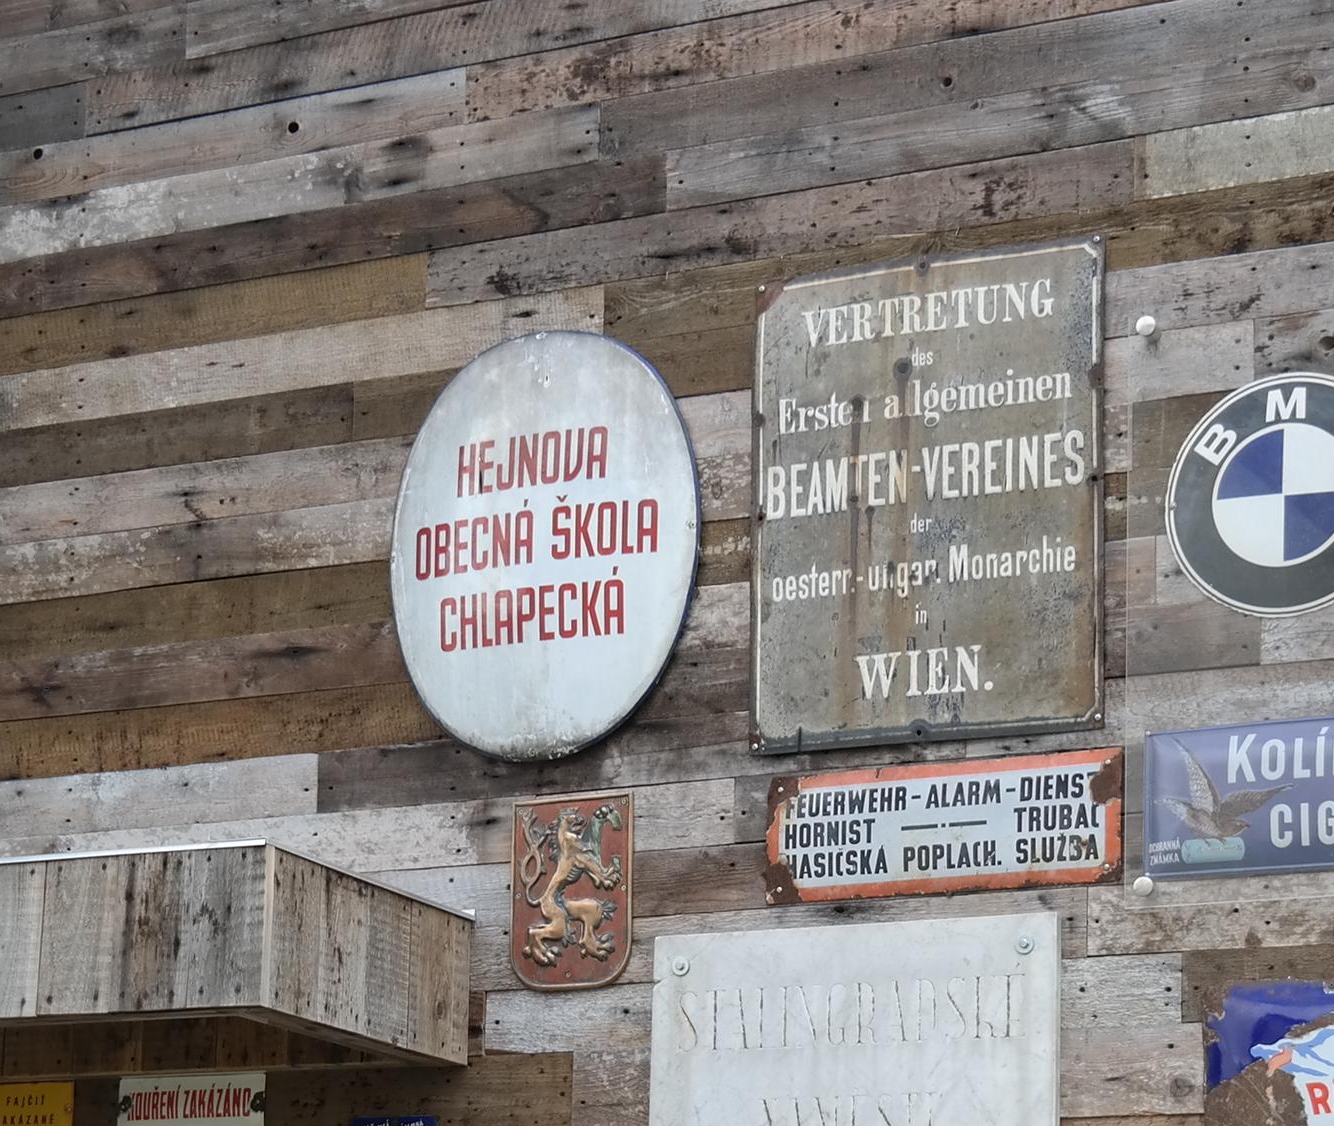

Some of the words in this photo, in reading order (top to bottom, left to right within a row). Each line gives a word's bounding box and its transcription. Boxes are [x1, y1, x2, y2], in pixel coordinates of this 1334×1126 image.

[801, 279, 1054, 347] VERTRETUNG
[911, 347, 933, 366] des
[884, 369, 1072, 428] algemeinen
[456, 426, 608, 498] HEJNOVA
[765, 430, 1084, 520] BEAMTEN-VEREINES
[415, 499, 534, 580] OBECNÁ
[551, 494, 658, 561] ŠKOLA
[910, 514, 931, 532] der
[948, 535, 1076, 583] Monarchie
[439, 567, 625, 652] CHLAPECKÁ
[915, 604, 927, 625] in
[853, 645, 993, 699] WIEN.
[784, 818, 876, 849] HORNIST
[1016, 834, 1100, 864] SLUŽBA
[183, 1082, 251, 1119] ZAKÁZÁNO
